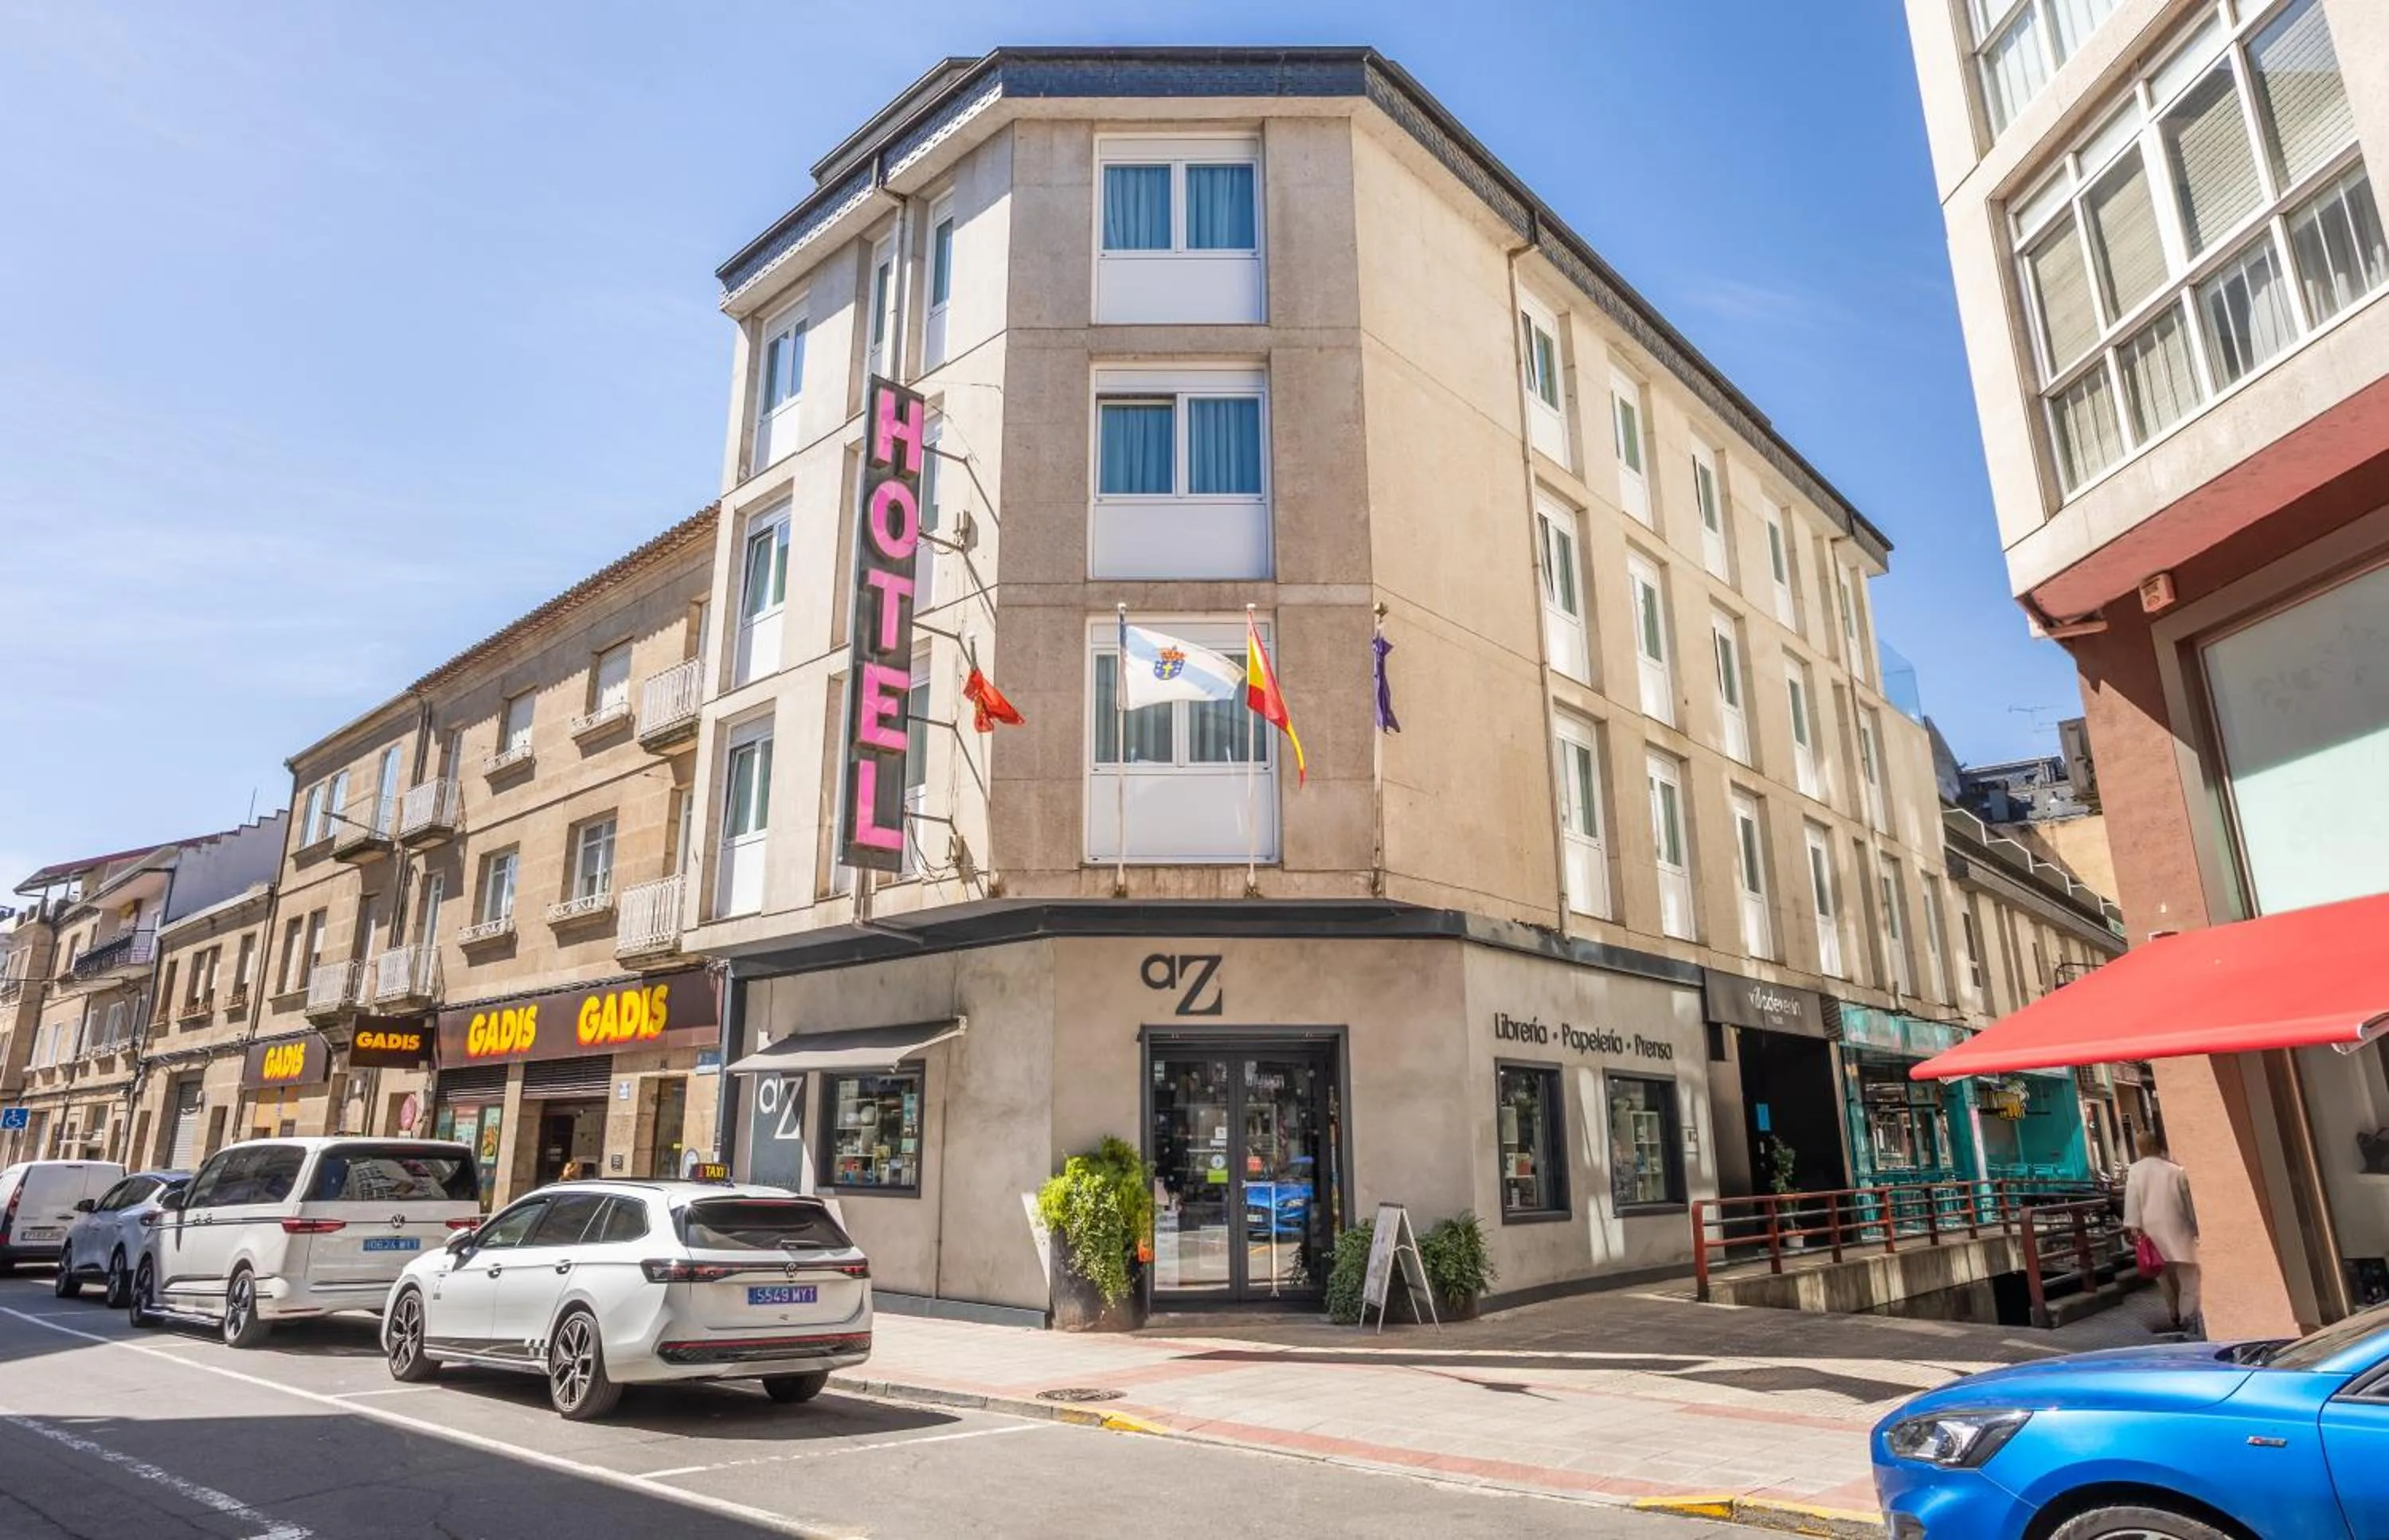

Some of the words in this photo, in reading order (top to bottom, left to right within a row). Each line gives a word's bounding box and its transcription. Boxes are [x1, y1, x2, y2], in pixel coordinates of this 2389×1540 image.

[854, 387, 925, 850] HOTEL
[464, 1005, 538, 1057] GADIS
[577, 984, 667, 1046] GADIS
[1494, 1012, 1548, 1045] Librería
[1561, 1022, 1623, 1055] Papelería
[1635, 1034, 1672, 1061] Prensa
[264, 1042, 306, 1081] GADIS
[356, 1031, 420, 1051] GADIS
[705, 1165, 724, 1178] TAXI
[757, 1288, 789, 1303] 5549
